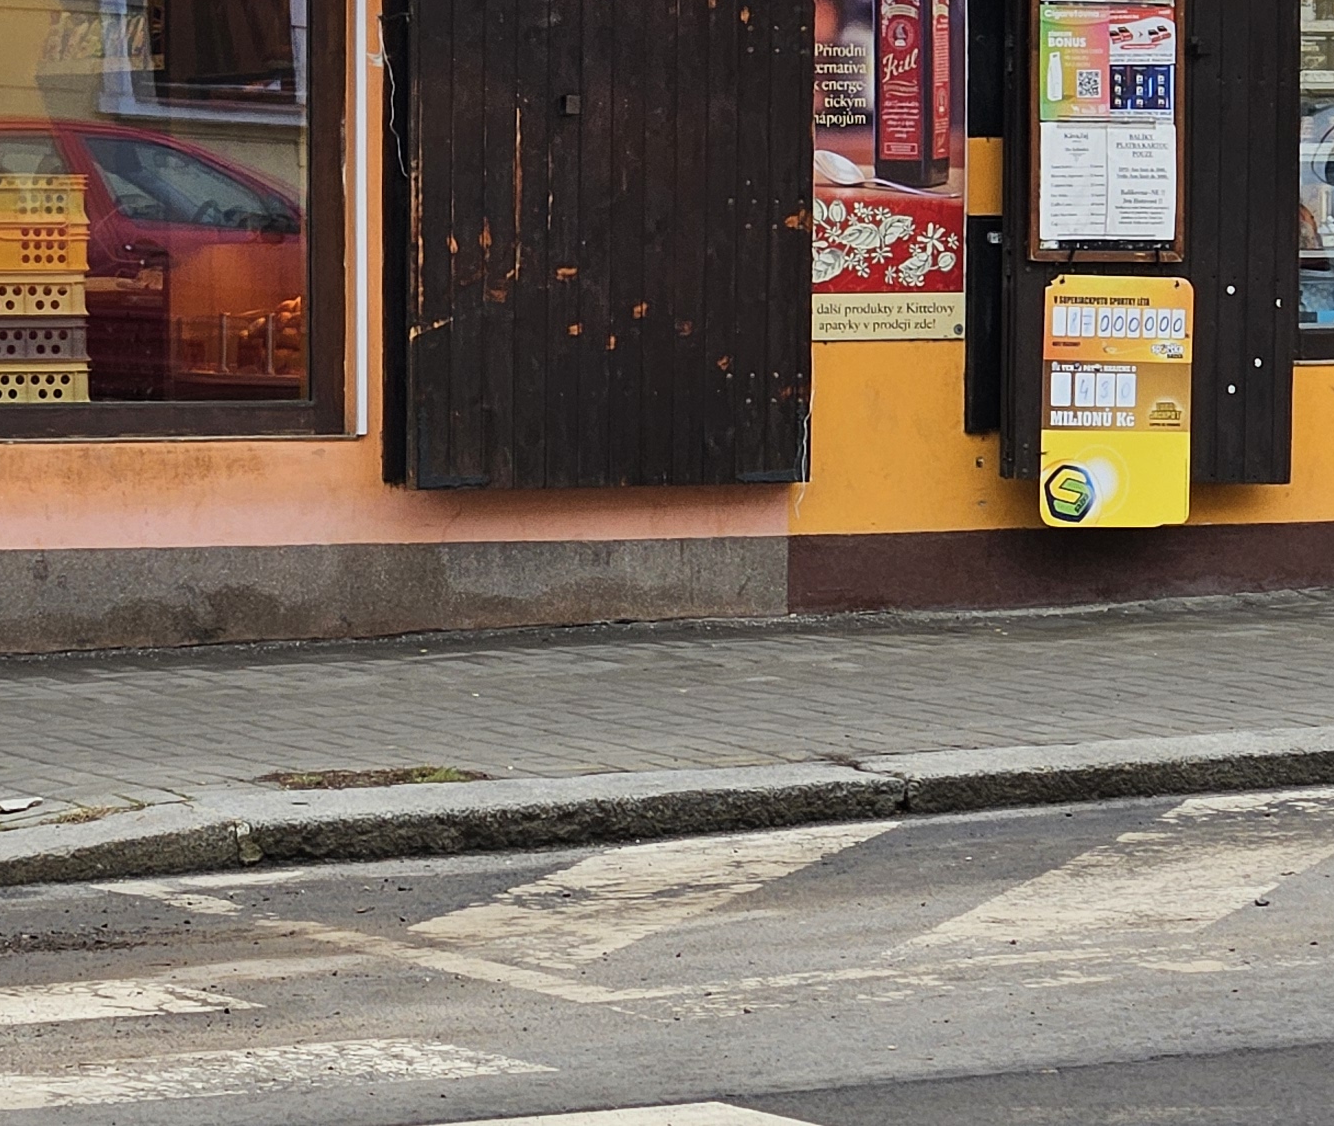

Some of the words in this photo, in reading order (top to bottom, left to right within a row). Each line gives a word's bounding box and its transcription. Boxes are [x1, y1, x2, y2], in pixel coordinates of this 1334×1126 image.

[1048, 37, 1086, 48] BONUS
[882, 48, 919, 83] Kitl
[824, 94, 866, 110] tickým
[817, 303, 841, 314] další
[844, 303, 893, 316] produkty
[819, 319, 860, 333] apatyky
[873, 319, 911, 332] prodeji
[1050, 408, 1113, 427] MILIONŮ
[1116, 410, 1135, 426] Kč
